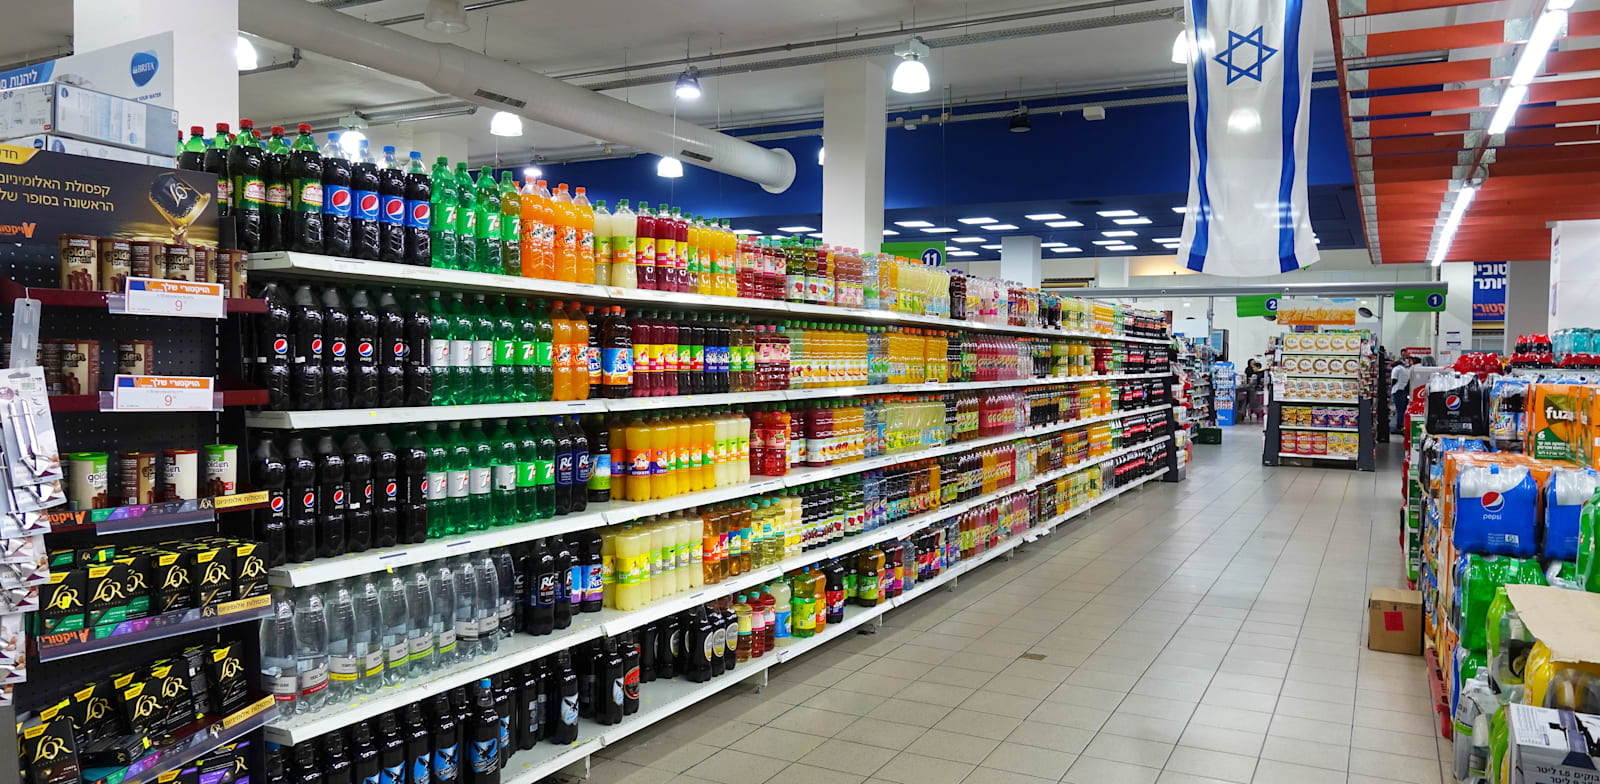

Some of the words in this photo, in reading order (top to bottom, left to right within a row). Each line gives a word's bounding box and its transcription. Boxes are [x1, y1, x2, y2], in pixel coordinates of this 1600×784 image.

[9, 69, 37, 88] ליהנות
[0, 148, 18, 160] חד
[0, 173, 60, 190] האלומיניום
[65, 180, 110, 198] קפסולת
[22, 189, 59, 206] בסופר
[63, 197, 114, 212] הראשונה
[924, 253, 938, 268] 11
[161, 282, 178, 293] שלך
[1269, 300, 1277, 309] 2
[1432, 296, 1438, 305] 1
[150, 377, 168, 388] שלך
[1537, 430, 1546, 439] 6
[1482, 513, 1502, 521] pepsi
[201, 562, 231, 585] L'OR
[239, 556, 267, 579] L'OR
[161, 565, 190, 589] L'OR
[90, 578, 126, 603] L'OR
[219, 657, 244, 682] L'OR
[162, 676, 188, 698] L'OR
[132, 694, 163, 721] L'OR
[32, 735, 73, 764] L'OR
[1536, 766, 1557, 775] ליטר
